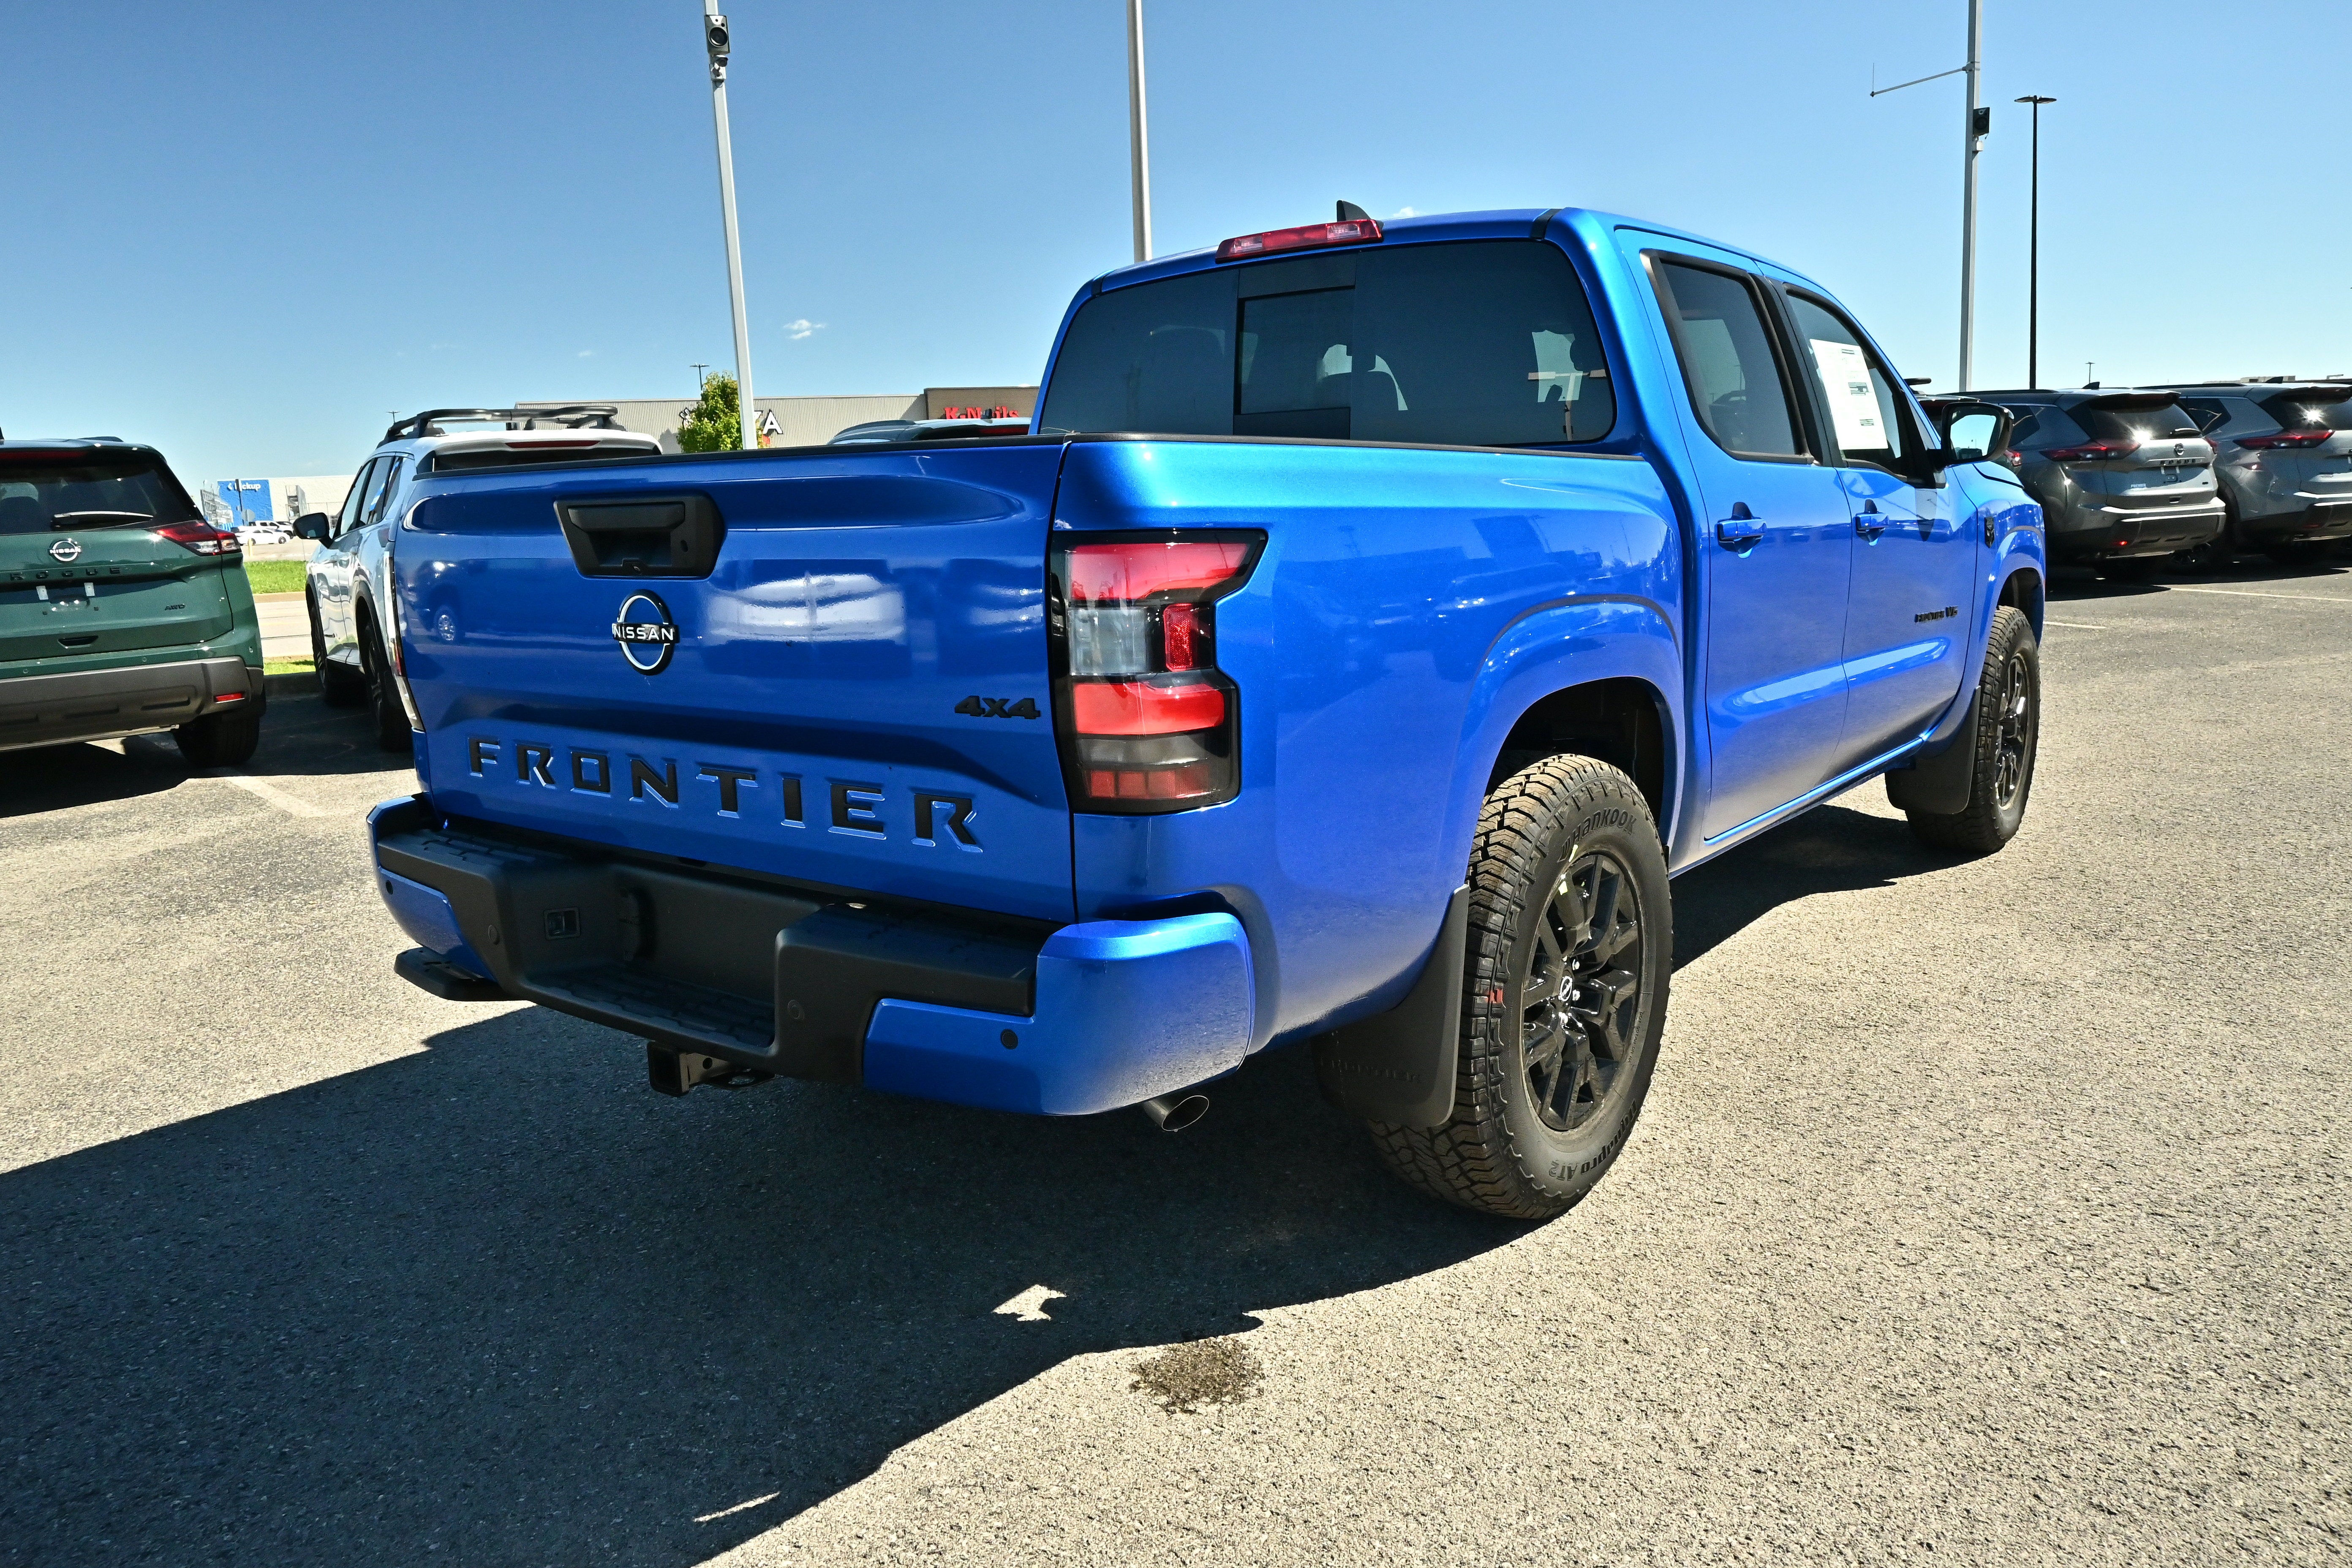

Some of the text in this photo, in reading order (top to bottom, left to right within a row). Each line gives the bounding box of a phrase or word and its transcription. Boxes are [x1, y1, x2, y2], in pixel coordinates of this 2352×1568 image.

[945, 406, 1019, 419] K-Nils
[234, 482, 261, 491] ckup
[10, 567, 121, 581] ROGUE
[613, 626, 674, 641] NISSAN
[468, 737, 983, 854] FRONTIER
